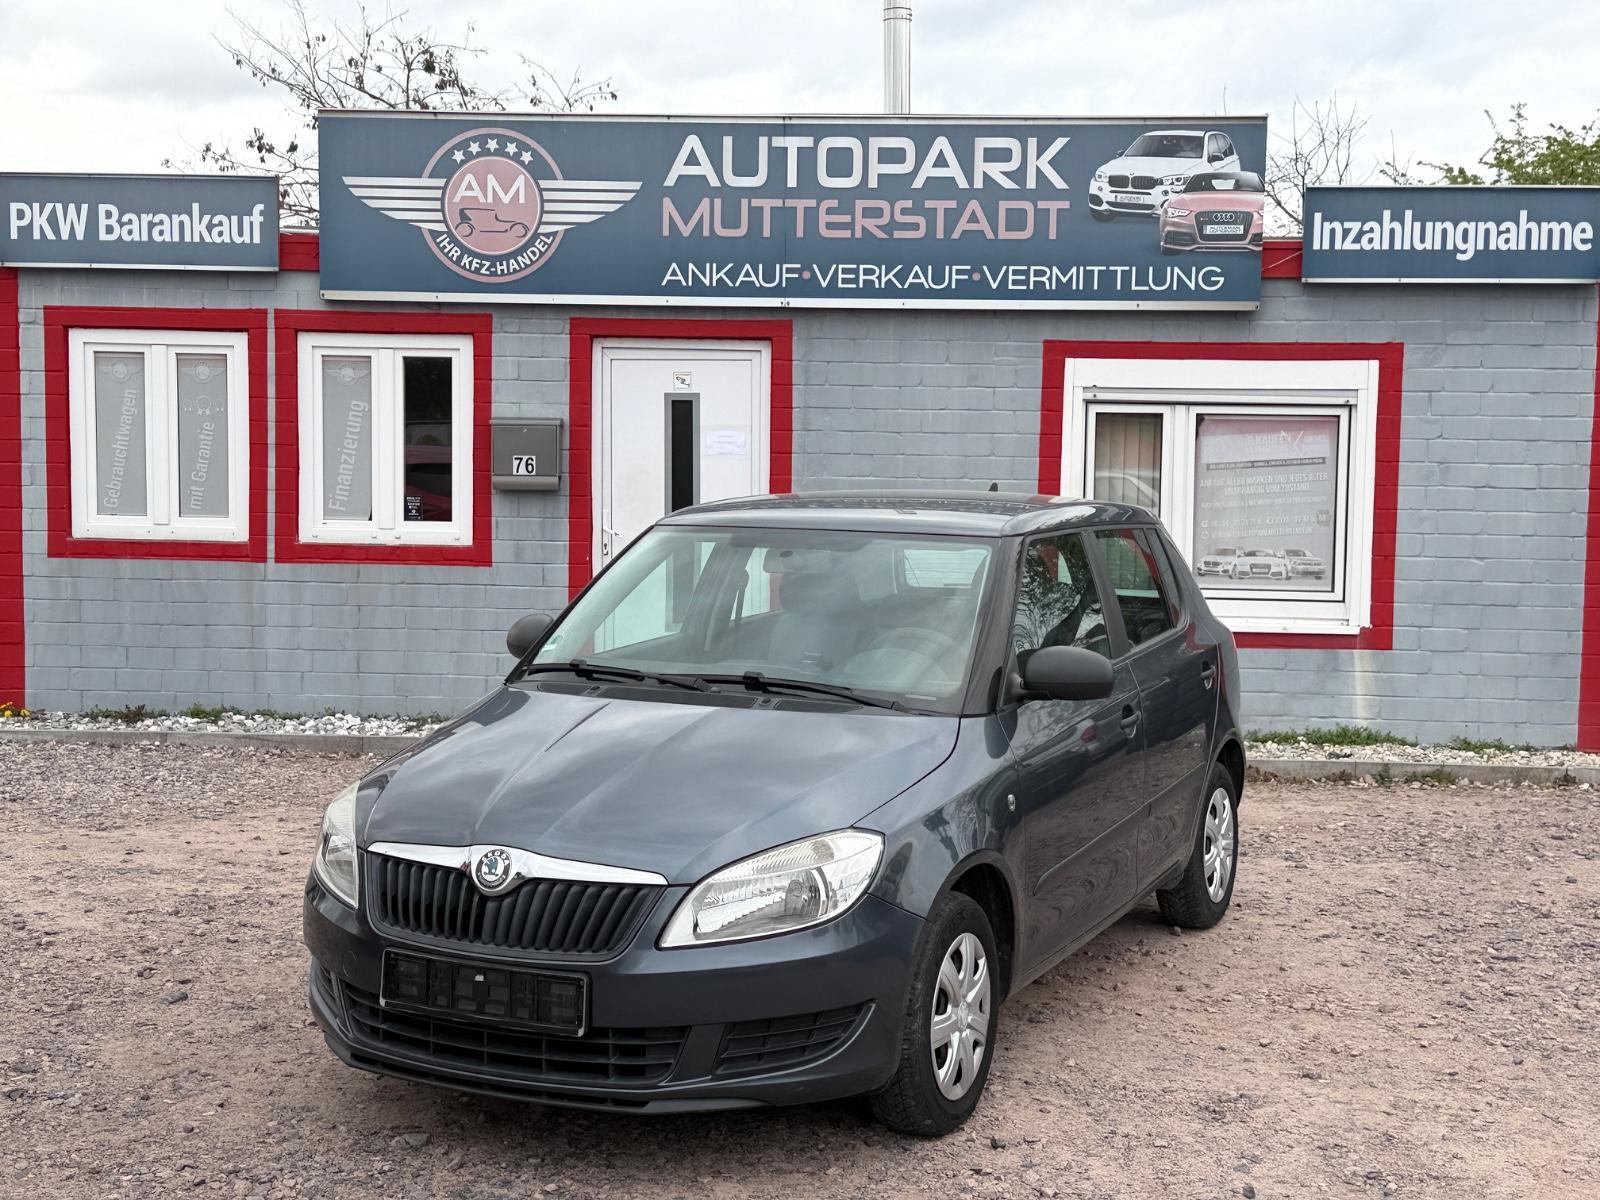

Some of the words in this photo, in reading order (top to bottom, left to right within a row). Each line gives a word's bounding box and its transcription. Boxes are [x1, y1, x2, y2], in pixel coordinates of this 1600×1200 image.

[663, 135, 1070, 190] AUTOPARK
[452, 173, 526, 204] AM
[9, 202, 89, 241] PKW
[97, 202, 265, 244] Barankauf
[662, 197, 1072, 241] MUTTERSTADT
[1312, 209, 1594, 262] Inzahlungnahme
[436, 234, 461, 261] IHR
[460, 235, 554, 275] KFZ-HANDEL
[661, 262, 801, 288] ANKAUF
[812, 264, 971, 290] VERKAUF
[982, 265, 1225, 291] VERMITTLUNG
[103, 389, 138, 508] Gebrauchtwagen
[191, 421, 215, 482] Garantie
[328, 400, 369, 511] Finanzierung
[513, 456, 535, 475] 76
[188, 486, 204, 510] mit
